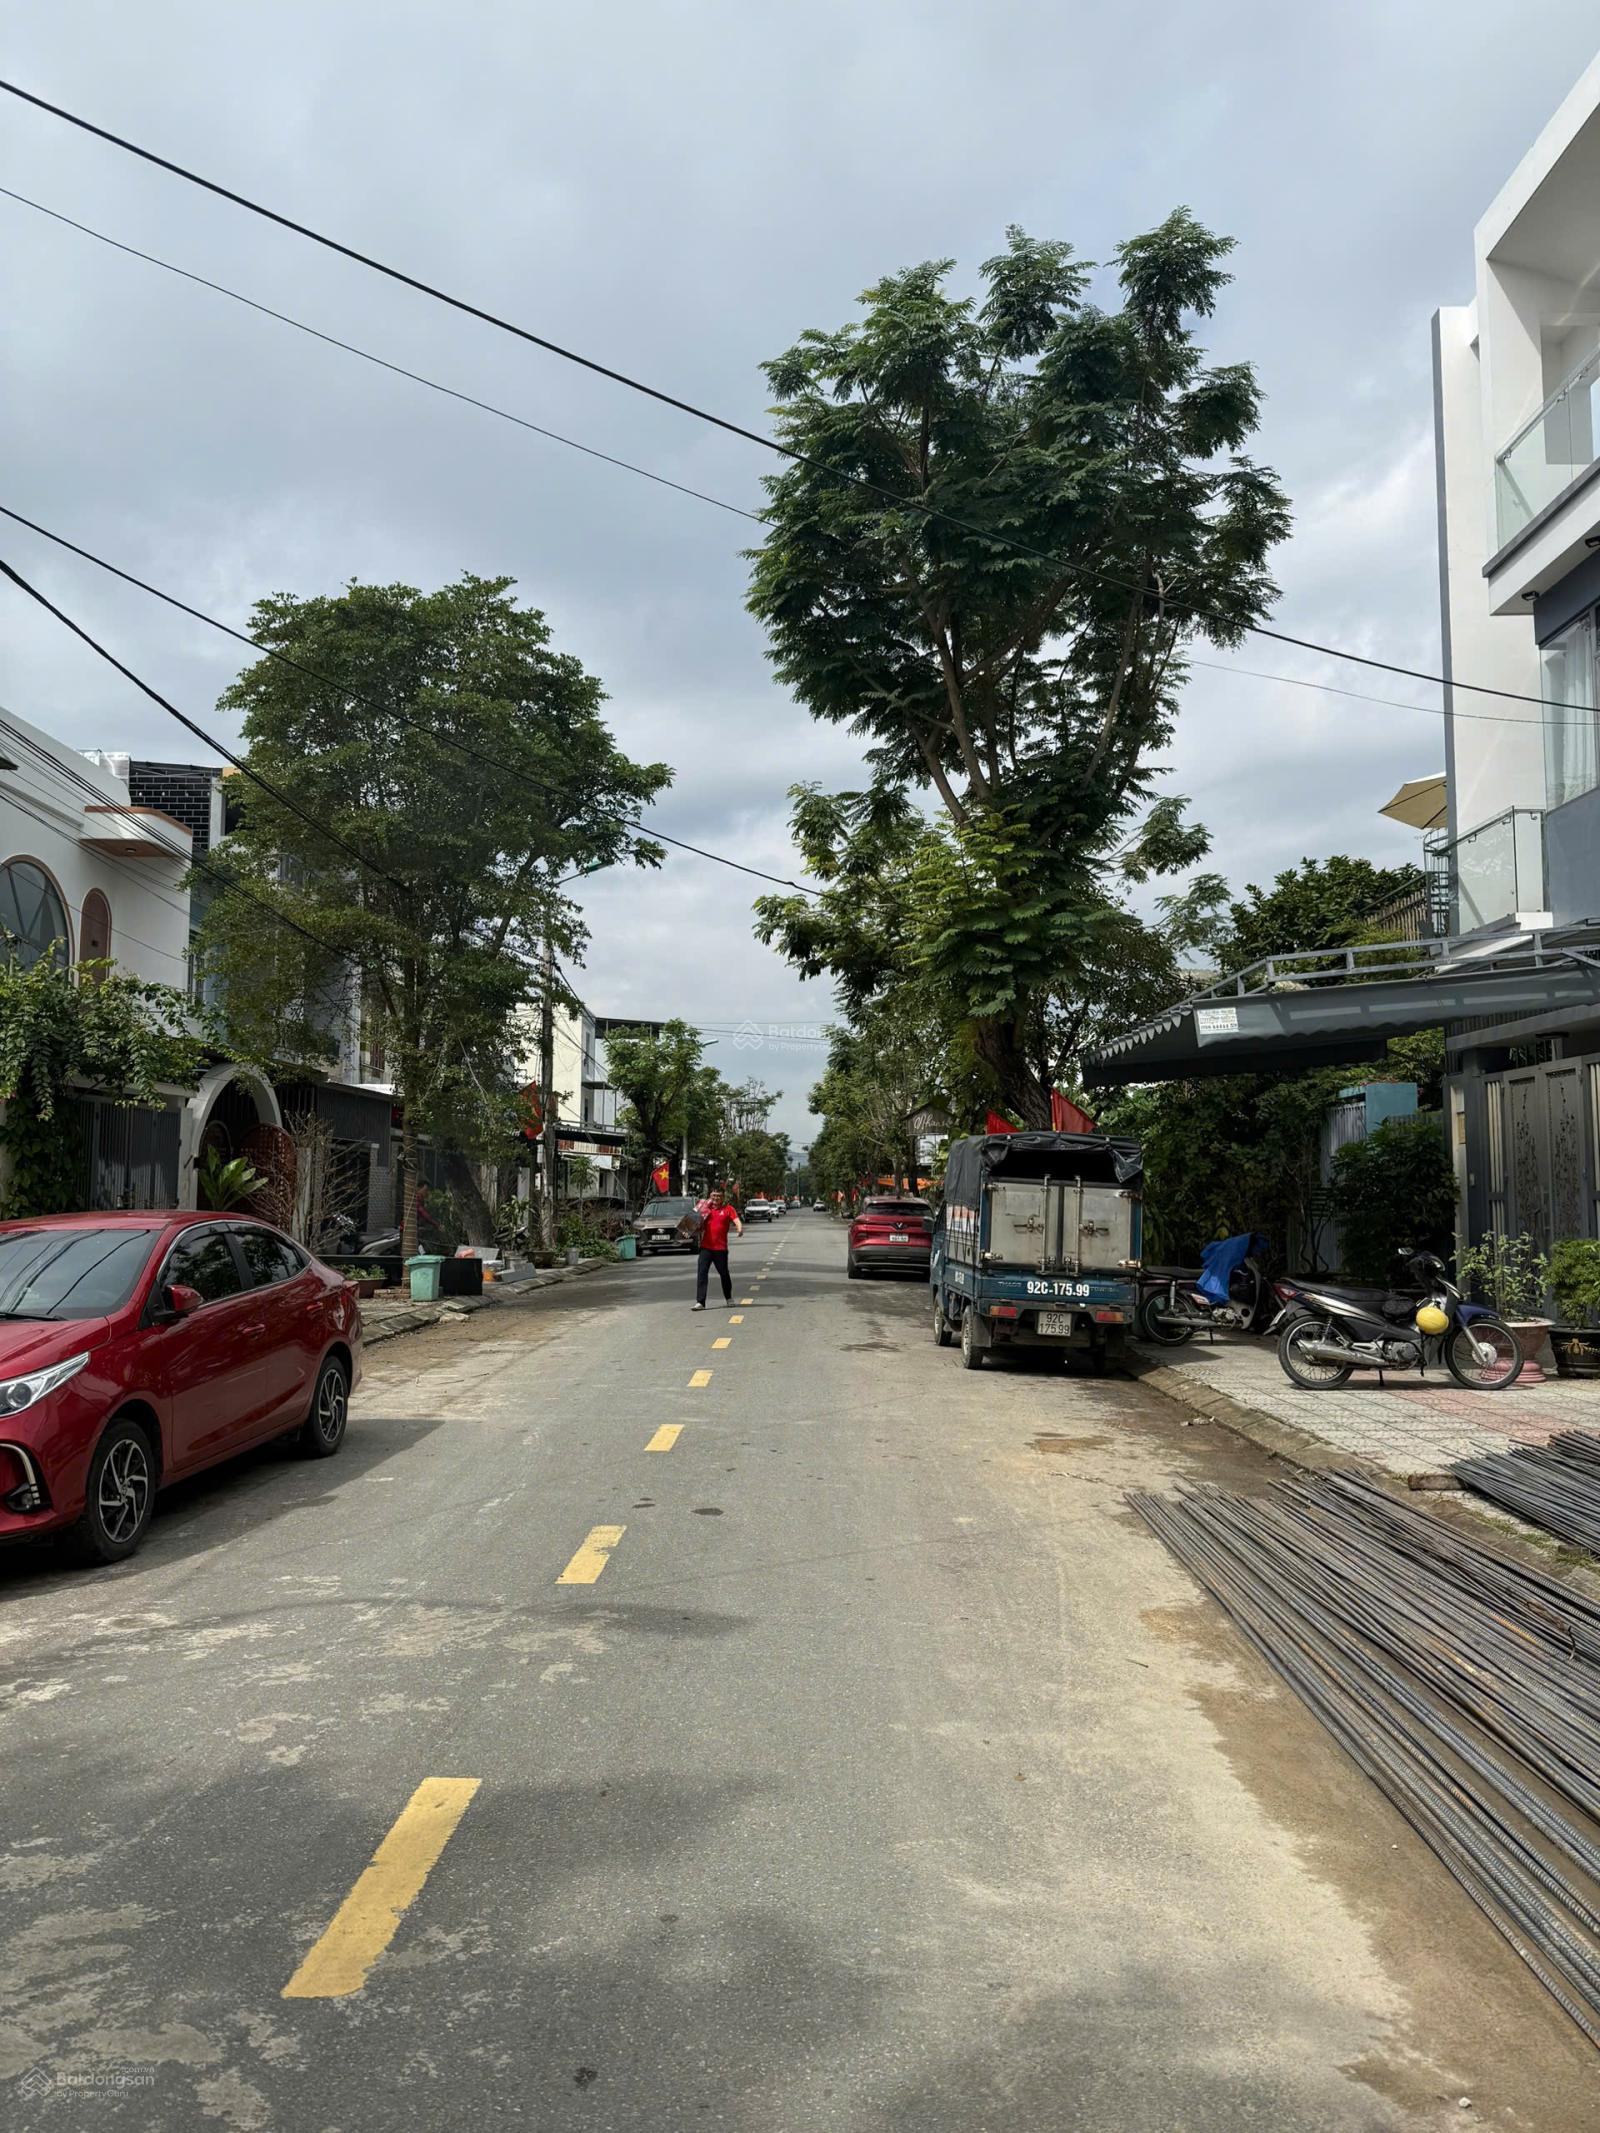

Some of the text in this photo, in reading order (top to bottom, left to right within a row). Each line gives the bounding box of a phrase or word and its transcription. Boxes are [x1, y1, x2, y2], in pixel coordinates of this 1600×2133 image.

[1027, 1281, 1090, 1297] 92C-175.99
[1046, 1313, 1064, 1323] 92C
[1039, 1323, 1070, 1335] 175.99
